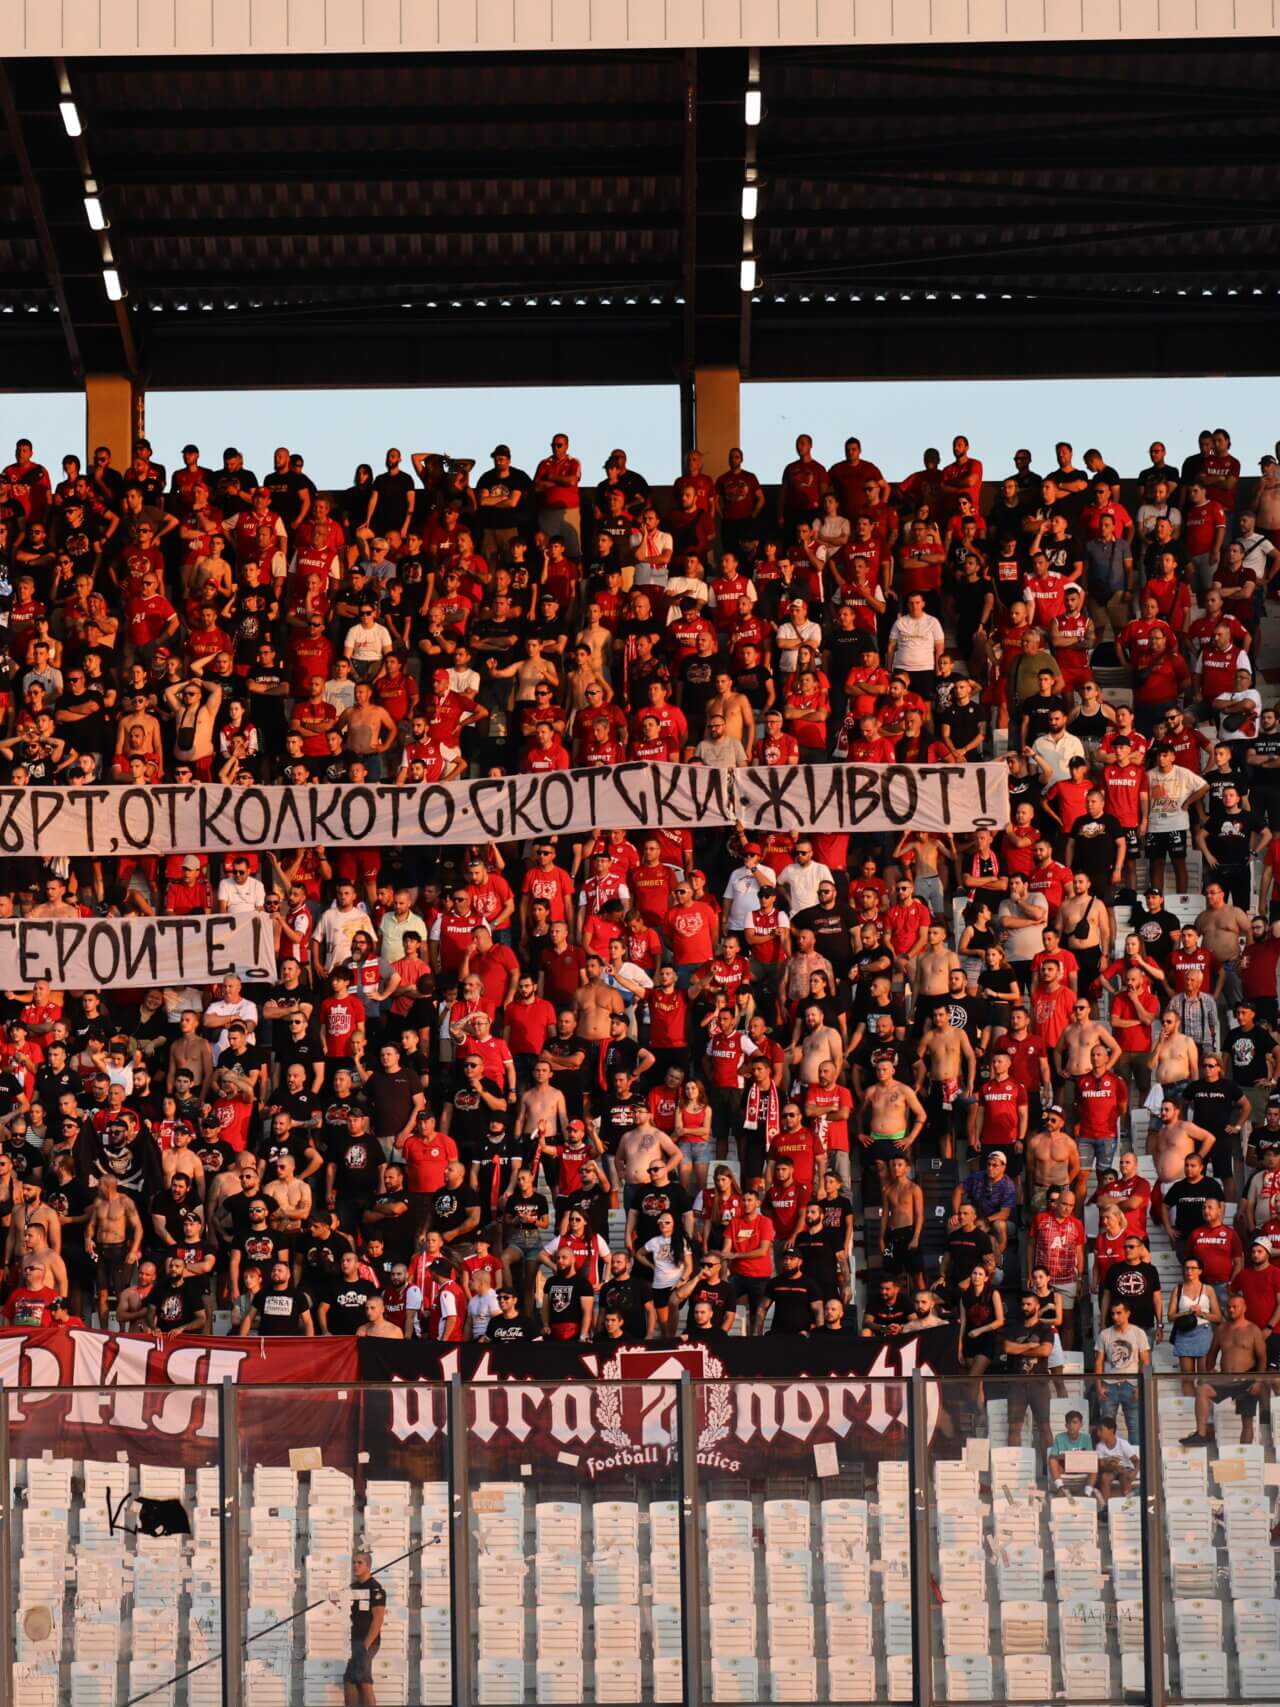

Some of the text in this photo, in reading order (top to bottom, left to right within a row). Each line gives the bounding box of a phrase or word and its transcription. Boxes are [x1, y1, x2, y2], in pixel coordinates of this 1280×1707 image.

[299, 558, 325, 567] WINBET
[637, 747, 664, 755] WINBET
[119, 785, 455, 848] ОТКОЛКОТО
[469, 762, 728, 837] СКОТСКИ
[748, 765, 997, 829] ЖИВОТ!
[715, 975, 742, 983] WINBET
[1052, 1236, 1066, 1248] A1
[587, 1446, 659, 1479] football
